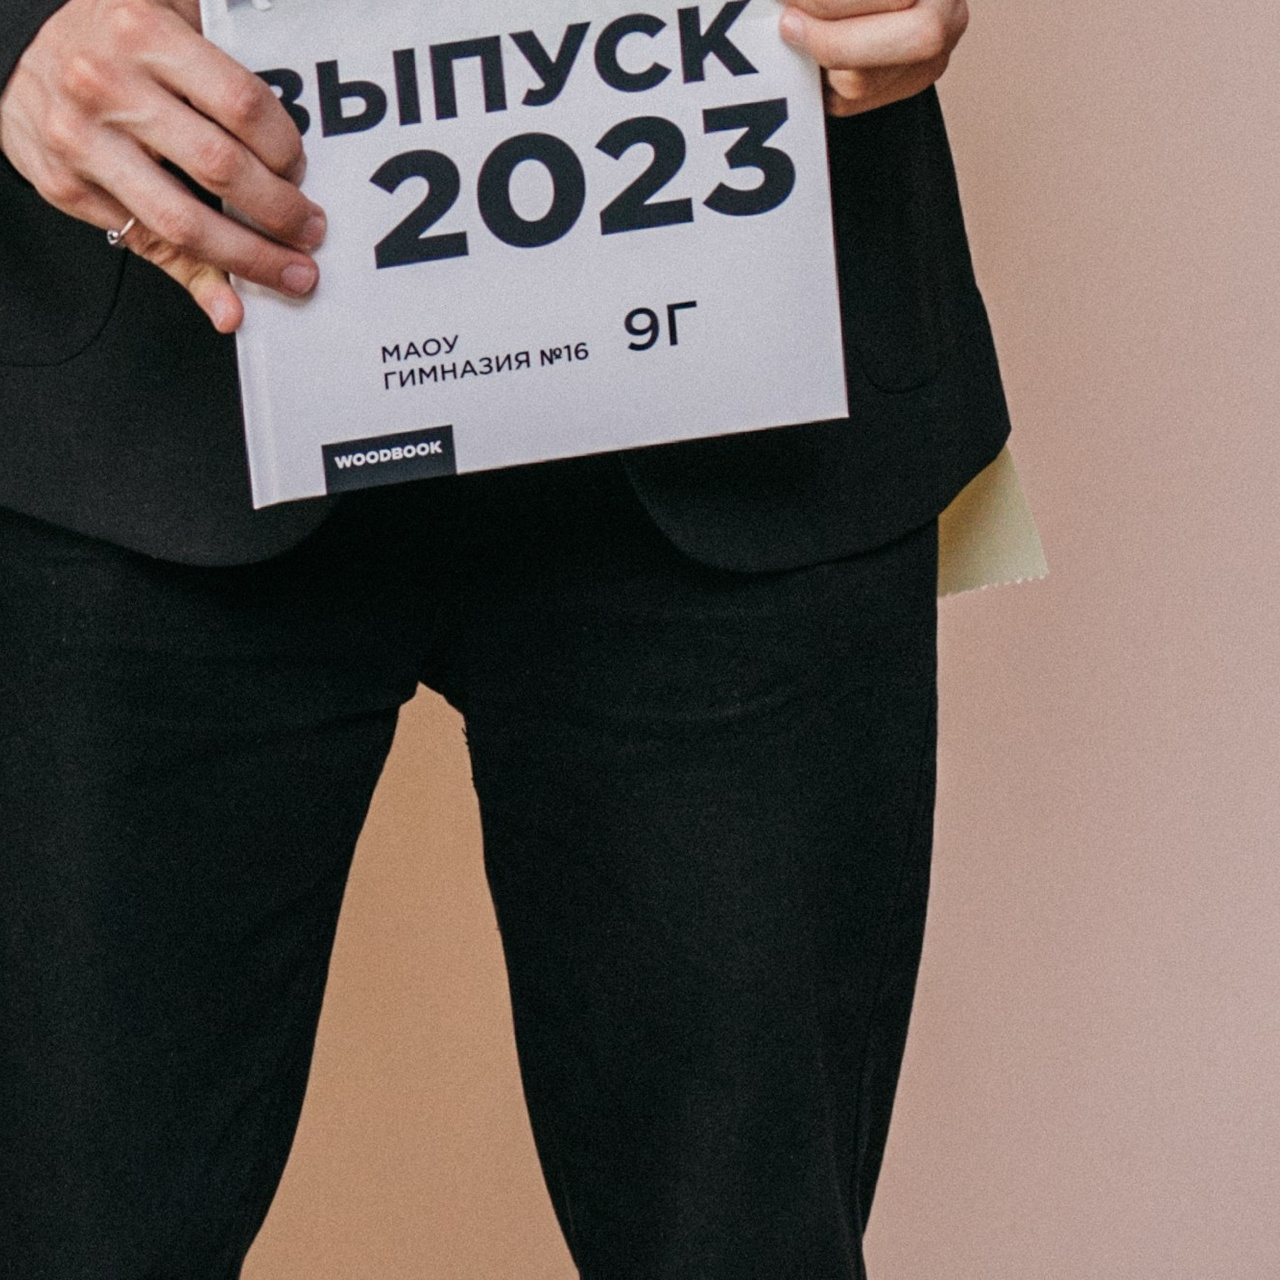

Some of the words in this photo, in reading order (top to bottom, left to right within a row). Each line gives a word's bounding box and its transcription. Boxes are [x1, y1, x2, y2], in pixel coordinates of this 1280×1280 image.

[368, 97, 796, 269] 2023
[381, 334, 459, 364] МАОУ
[623, 300, 698, 352] 9Г
[384, 351, 531, 390] ГИМНАЗИЯ
[540, 342, 589, 367] №16
[334, 440, 443, 470] WOODBOOK
